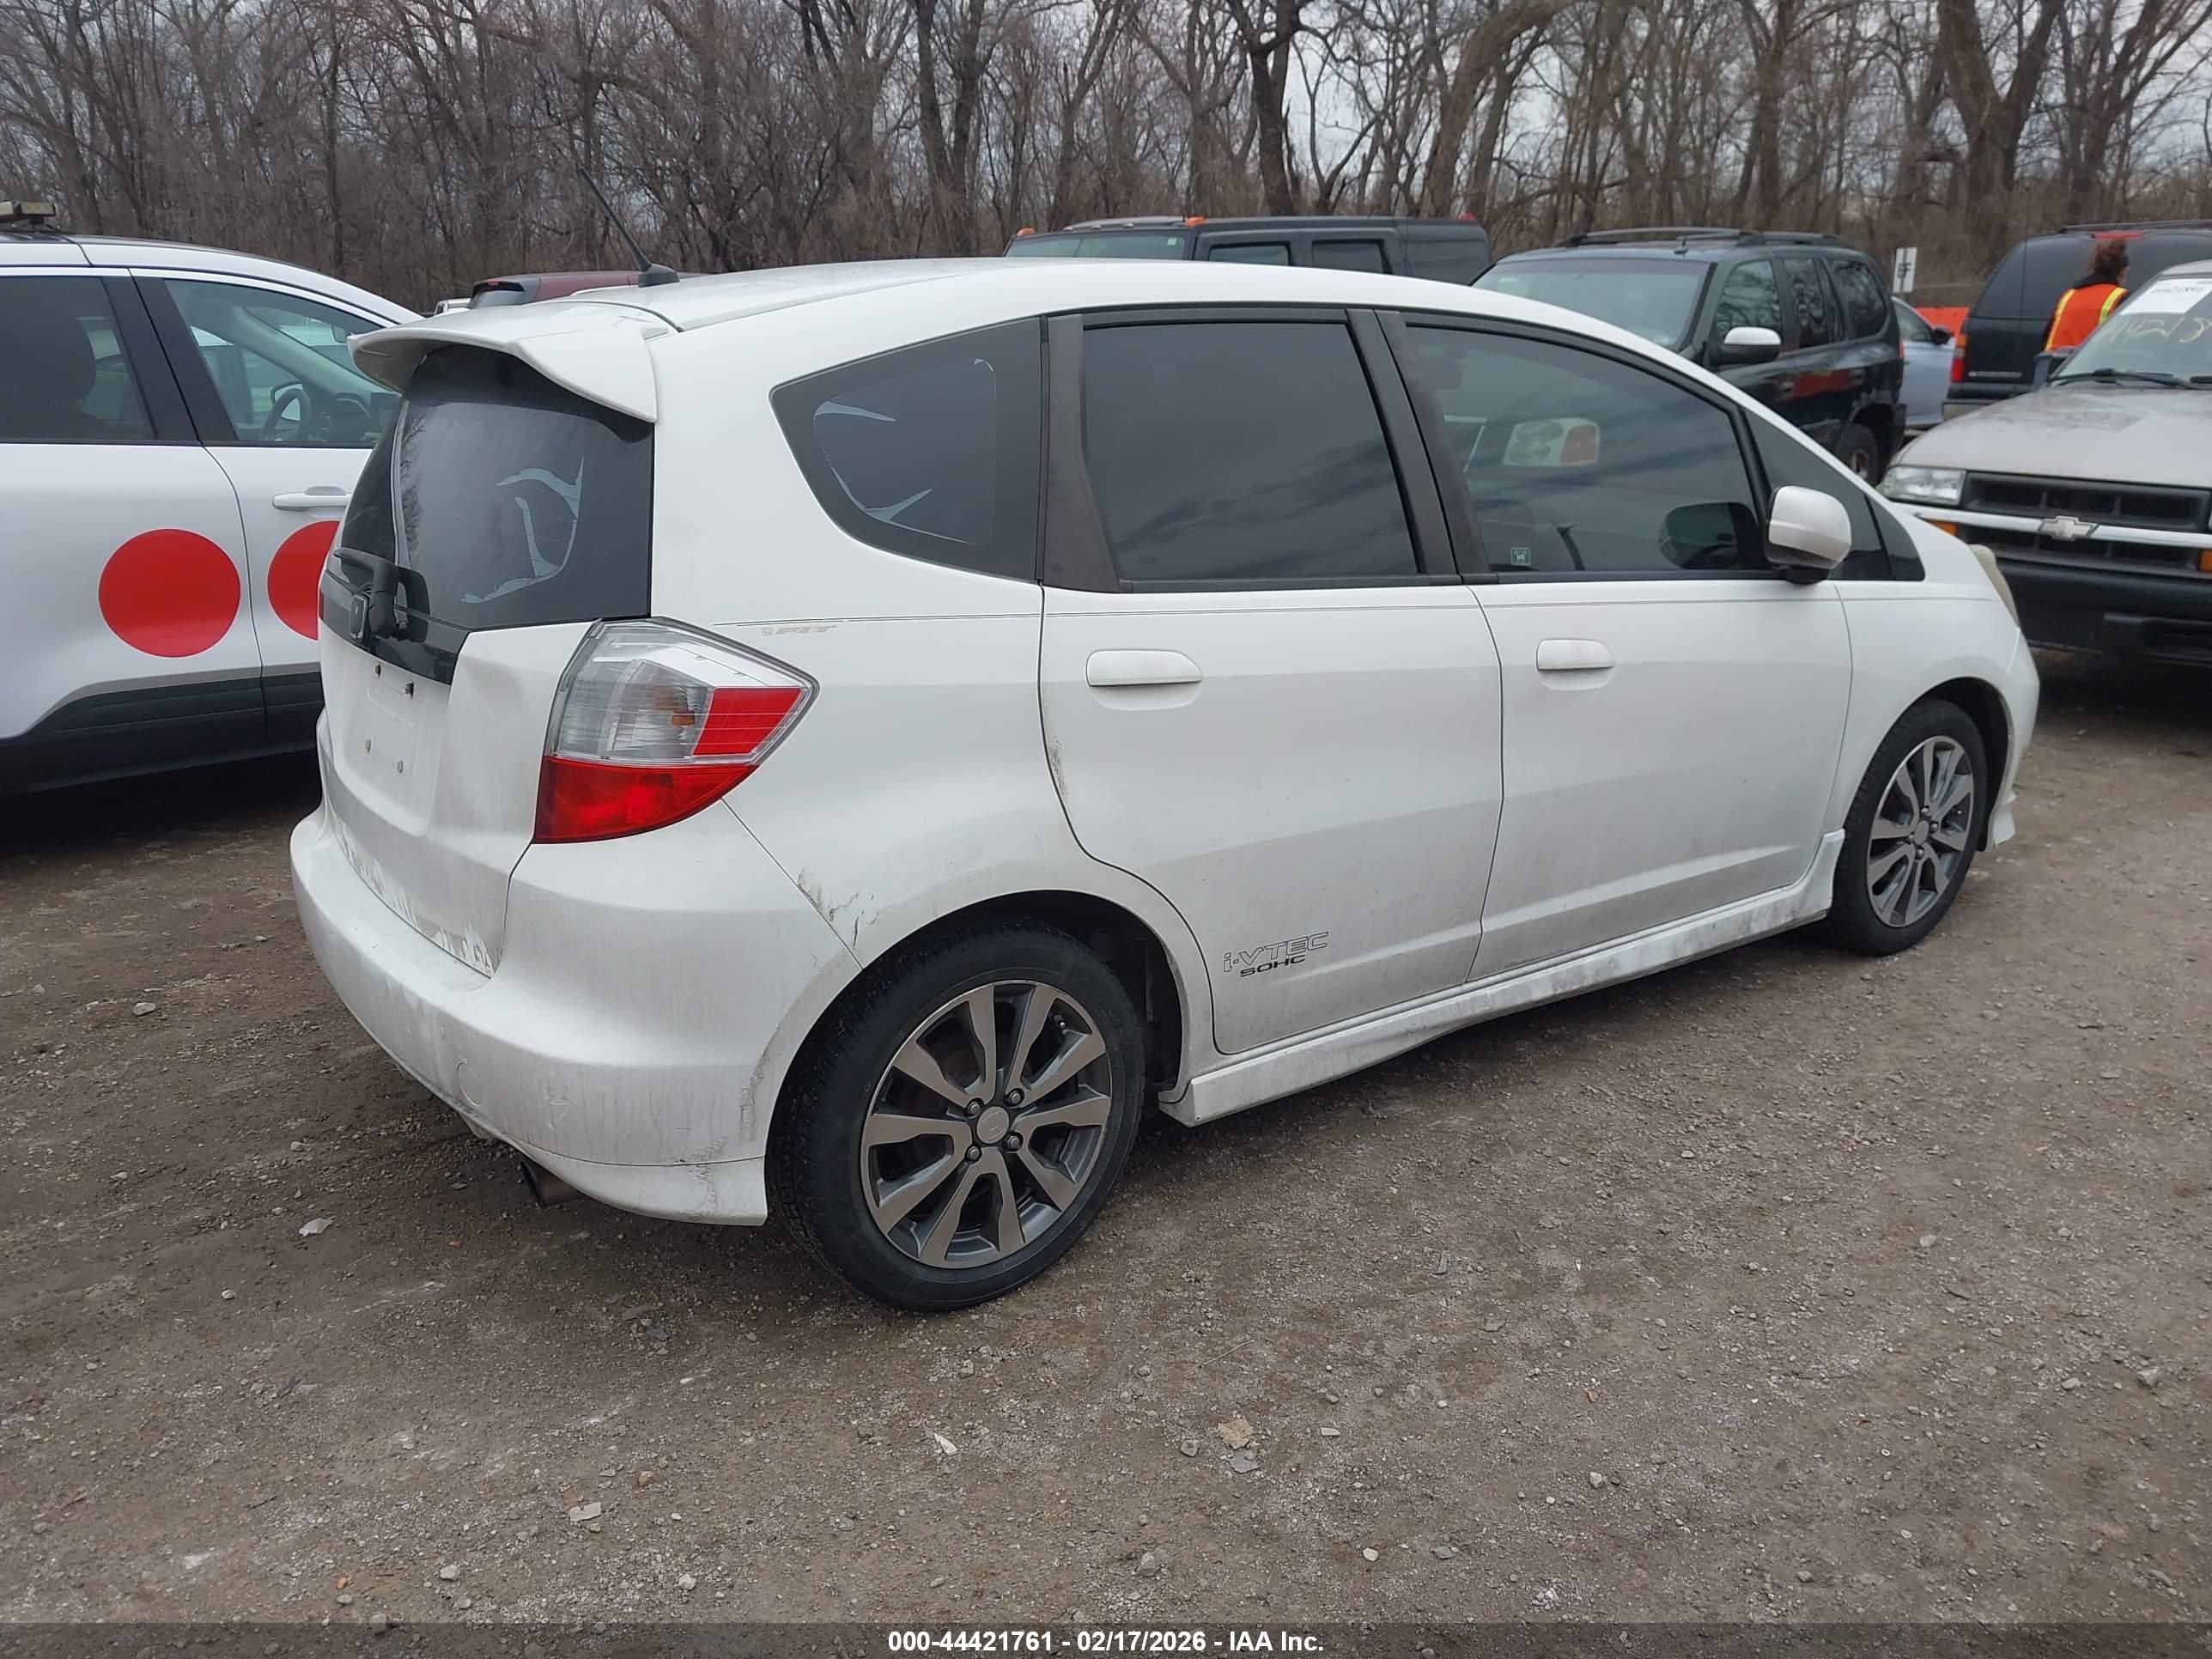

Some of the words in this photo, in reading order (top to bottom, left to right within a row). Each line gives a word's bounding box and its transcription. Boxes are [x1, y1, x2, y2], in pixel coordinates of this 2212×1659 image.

[775, 625, 837, 635] FIT
[1224, 931, 1329, 972] i-VTEC
[1240, 954, 1306, 977] SOHC
